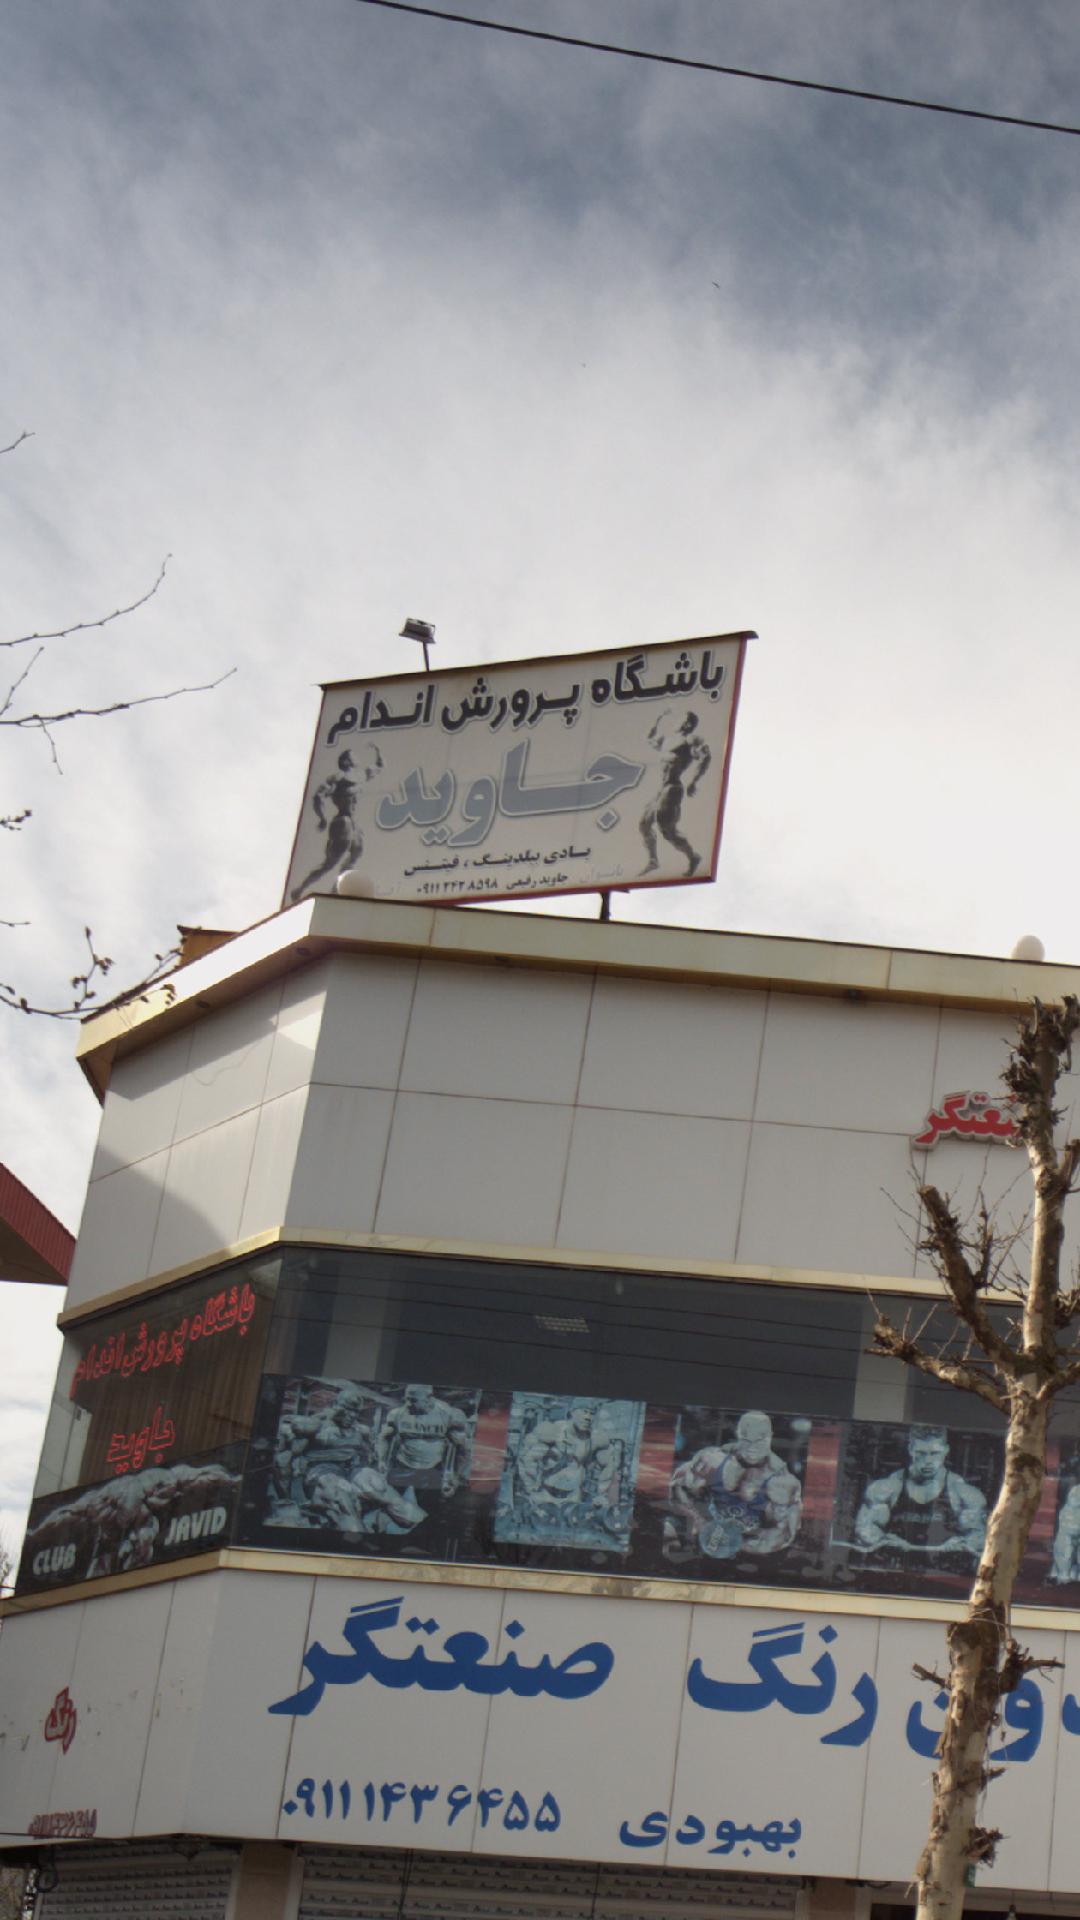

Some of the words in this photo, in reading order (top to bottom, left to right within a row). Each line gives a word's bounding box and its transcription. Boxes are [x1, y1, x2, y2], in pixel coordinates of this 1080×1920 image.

[441, 677, 581, 733] پرورش
[591, 650, 725, 703] باشگاه
[326, 685, 435, 745] اندام
[375, 738, 645, 848] جاوید
[543, 845, 592, 865] بادی
[913, 1090, 1022, 1145] نعتگر
[190, 1283, 256, 1341] باشگاه
[32, 1543, 77, 1576] CLUB
[164, 1506, 228, 1547] JAVID
[267, 1596, 615, 1717] صنعتگر
[687, 1621, 878, 1747] رنگ
[619, 1810, 802, 1859] بهبودی
